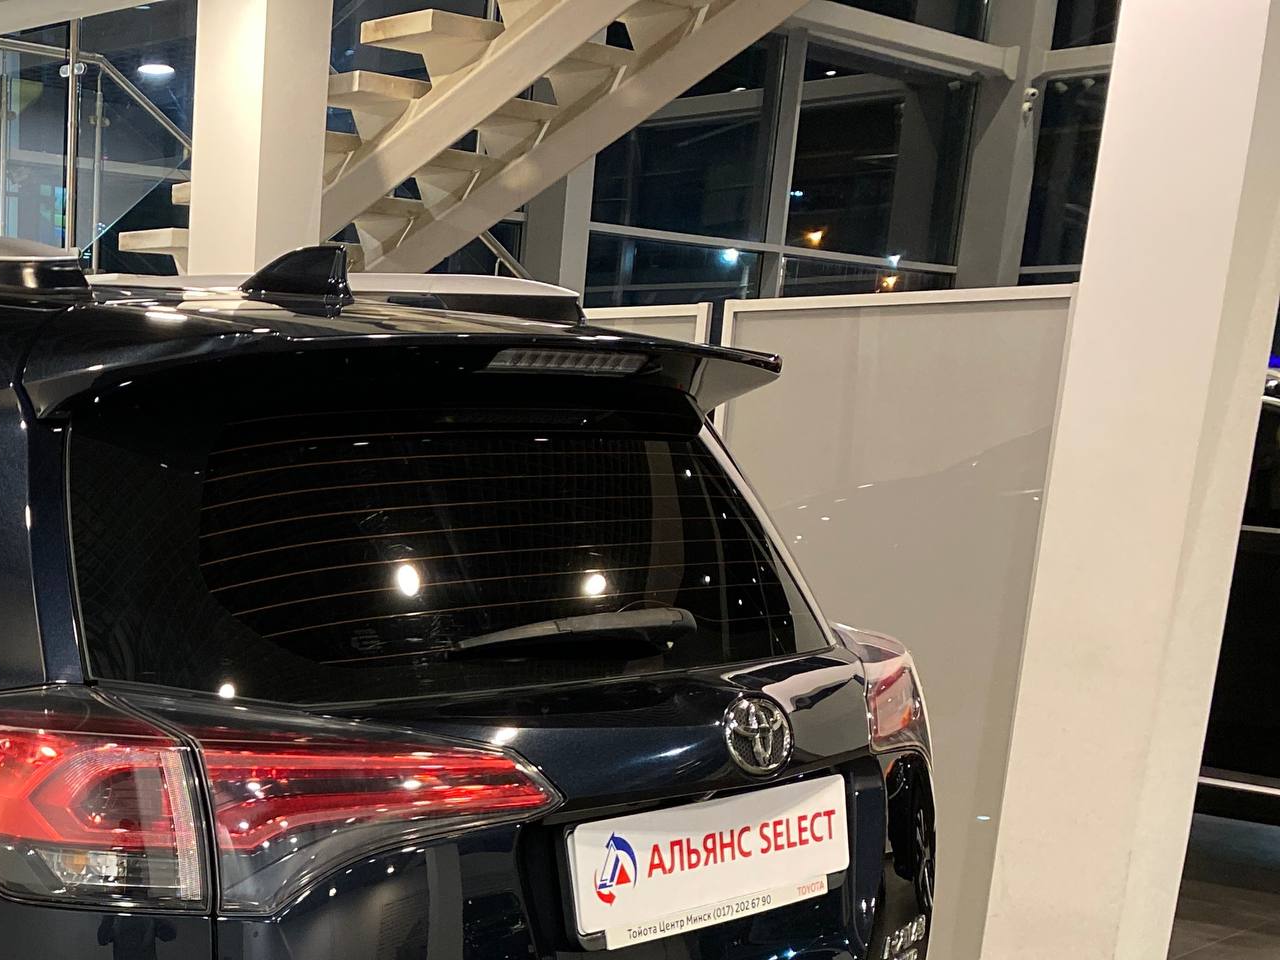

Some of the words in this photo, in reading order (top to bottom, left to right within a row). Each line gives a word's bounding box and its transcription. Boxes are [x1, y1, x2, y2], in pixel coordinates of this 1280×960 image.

[647, 825, 752, 878] АЛЬЯНС
[759, 809, 836, 854] SELECT
[797, 880, 825, 897] TOYOTA
[627, 926, 658, 939] Тойота
[659, 919, 685, 933] Центр
[686, 913, 712, 925] Минск
[713, 905, 734, 920] (017)
[735, 900, 751, 913] 202
[751, 897, 761, 909] 67
[761, 894, 772, 906] 90
